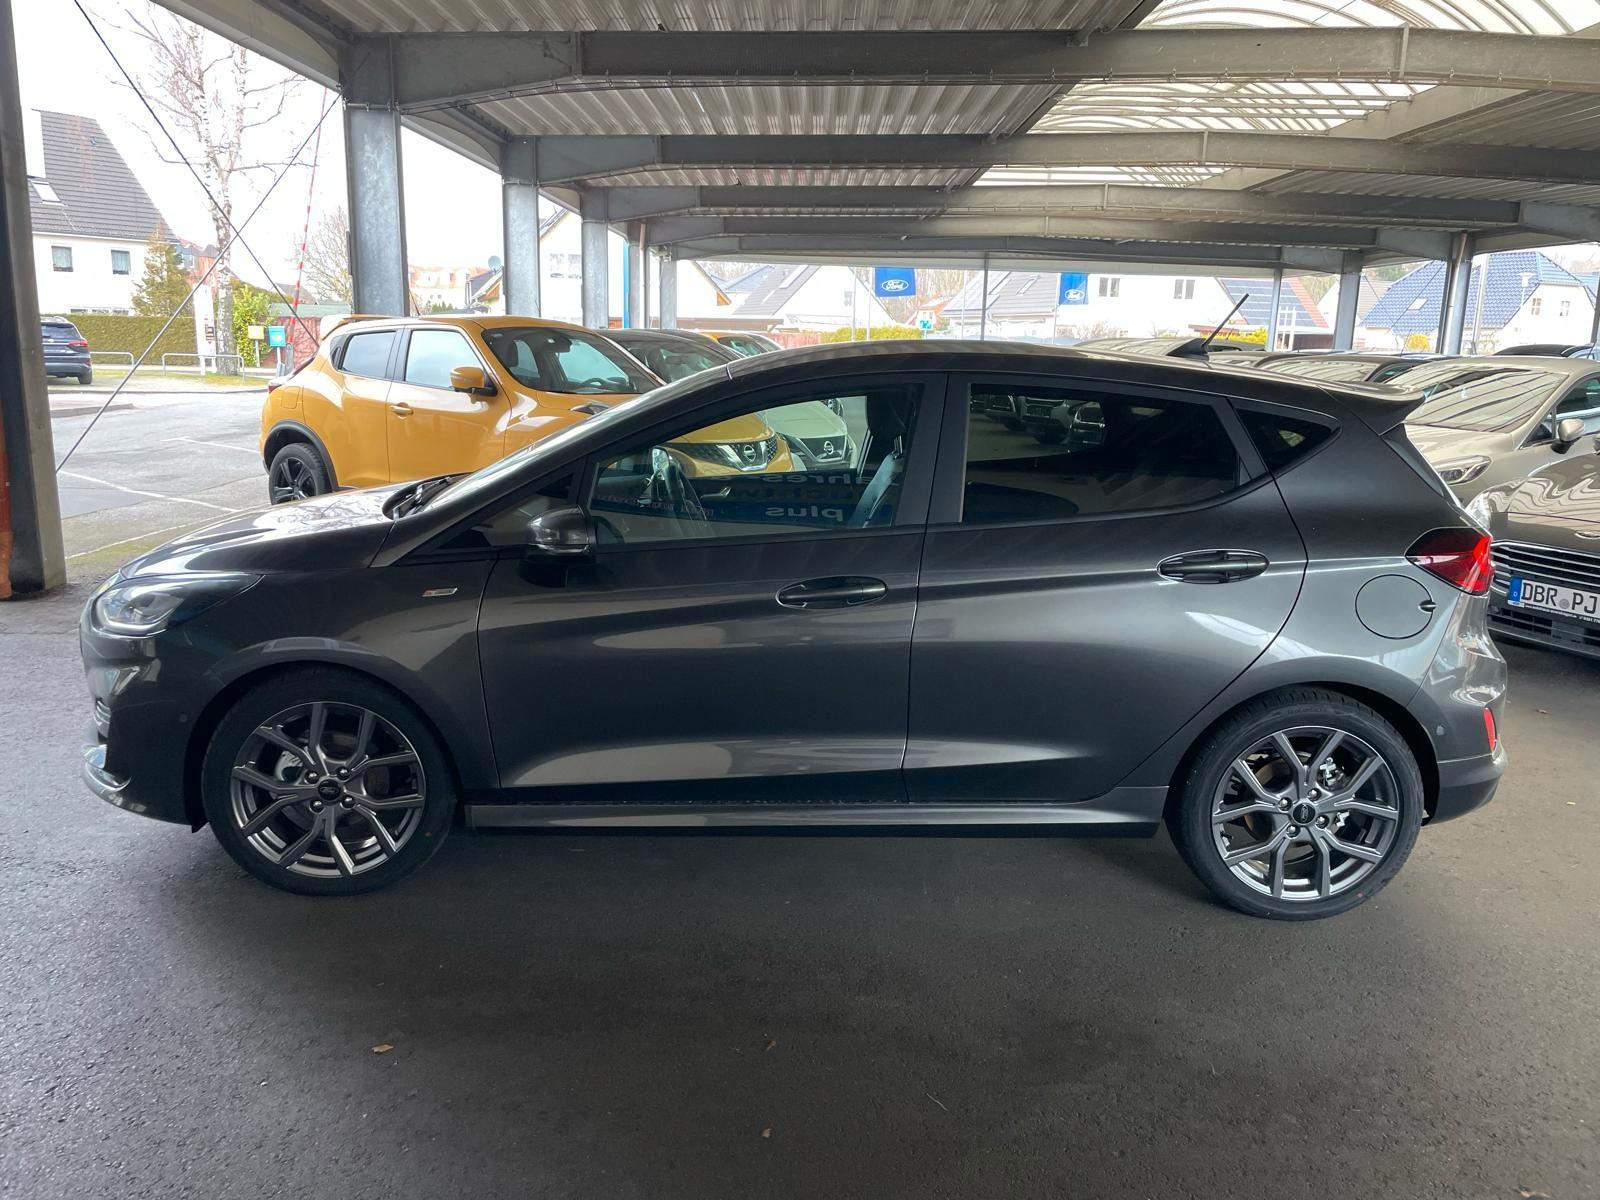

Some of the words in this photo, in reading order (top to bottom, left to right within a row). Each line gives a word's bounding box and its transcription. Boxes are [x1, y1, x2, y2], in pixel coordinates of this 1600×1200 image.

[884, 280, 906, 291] Ford
[1521, 582, 1557, 607] DBR
[1572, 592, 1598, 615] PJ
